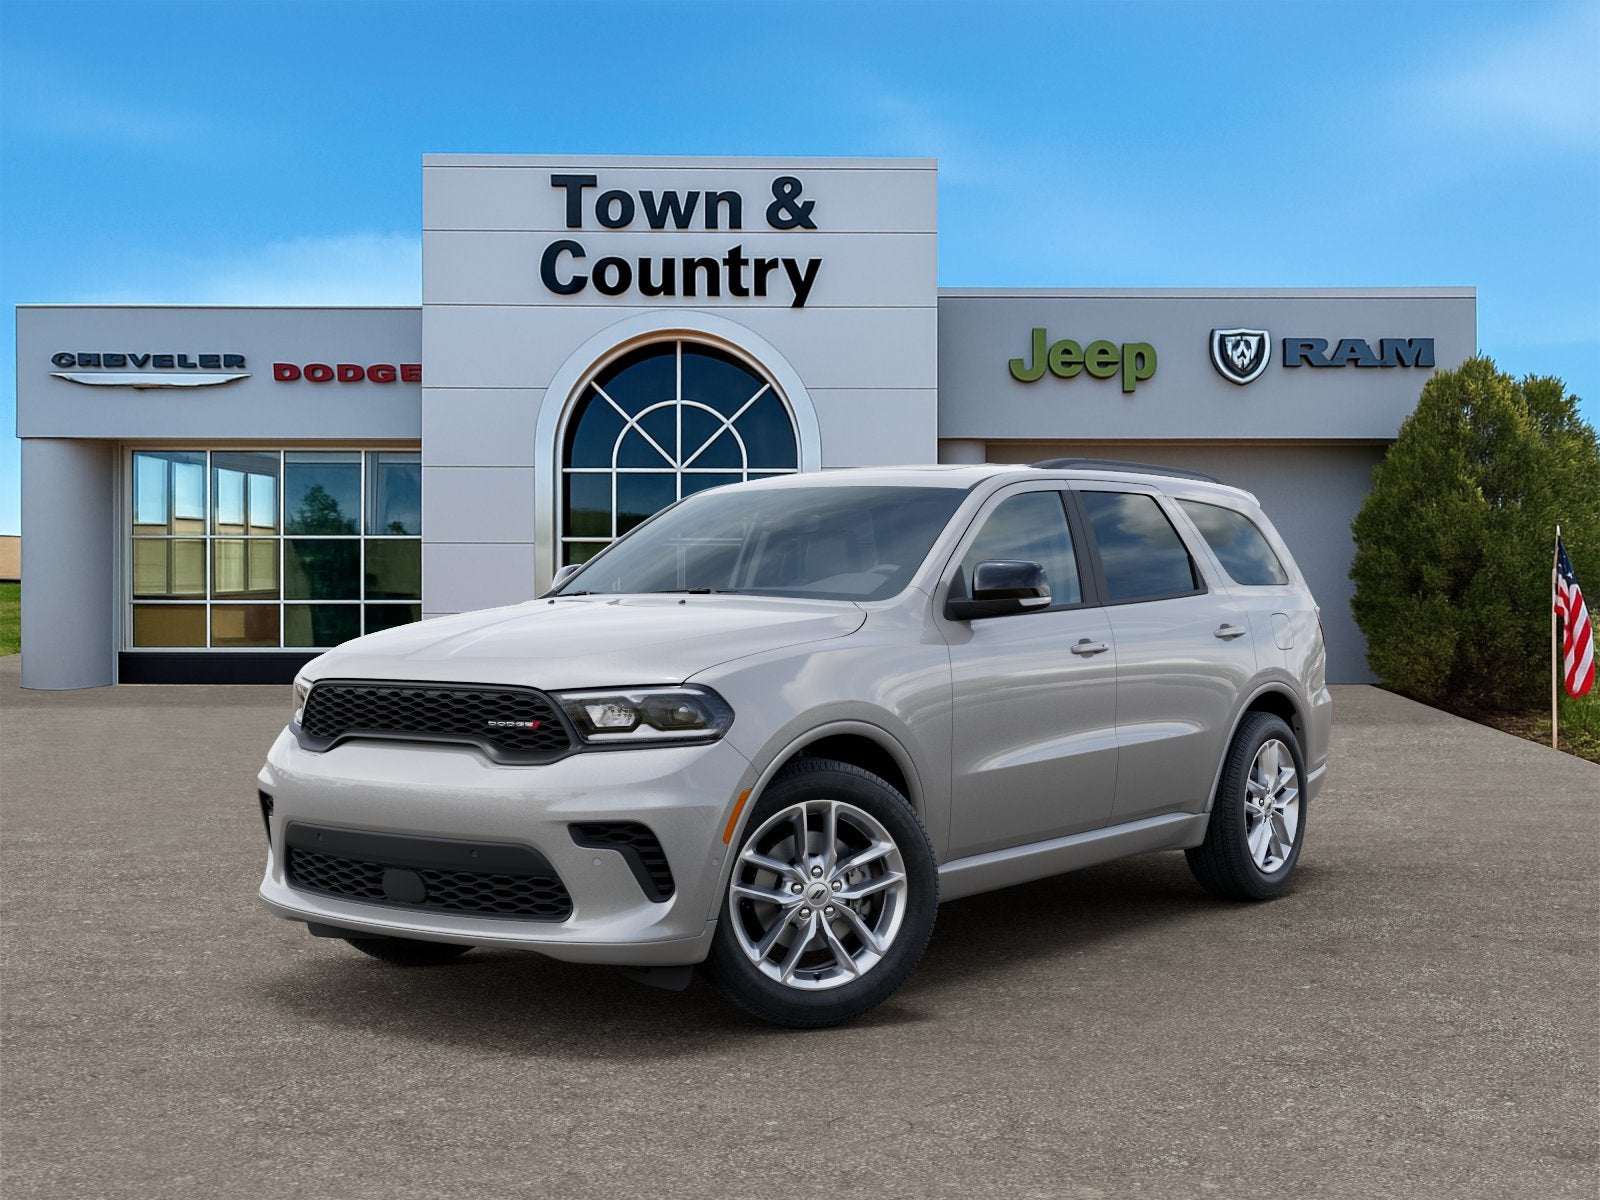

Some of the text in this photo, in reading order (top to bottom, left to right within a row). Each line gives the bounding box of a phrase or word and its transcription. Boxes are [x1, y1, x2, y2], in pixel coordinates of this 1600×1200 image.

[550, 174, 818, 230] Town &
[540, 239, 822, 308] Country
[273, 362, 422, 383] DODGE
[1009, 328, 1157, 392] Jeep
[1282, 337, 1435, 368] RAM
